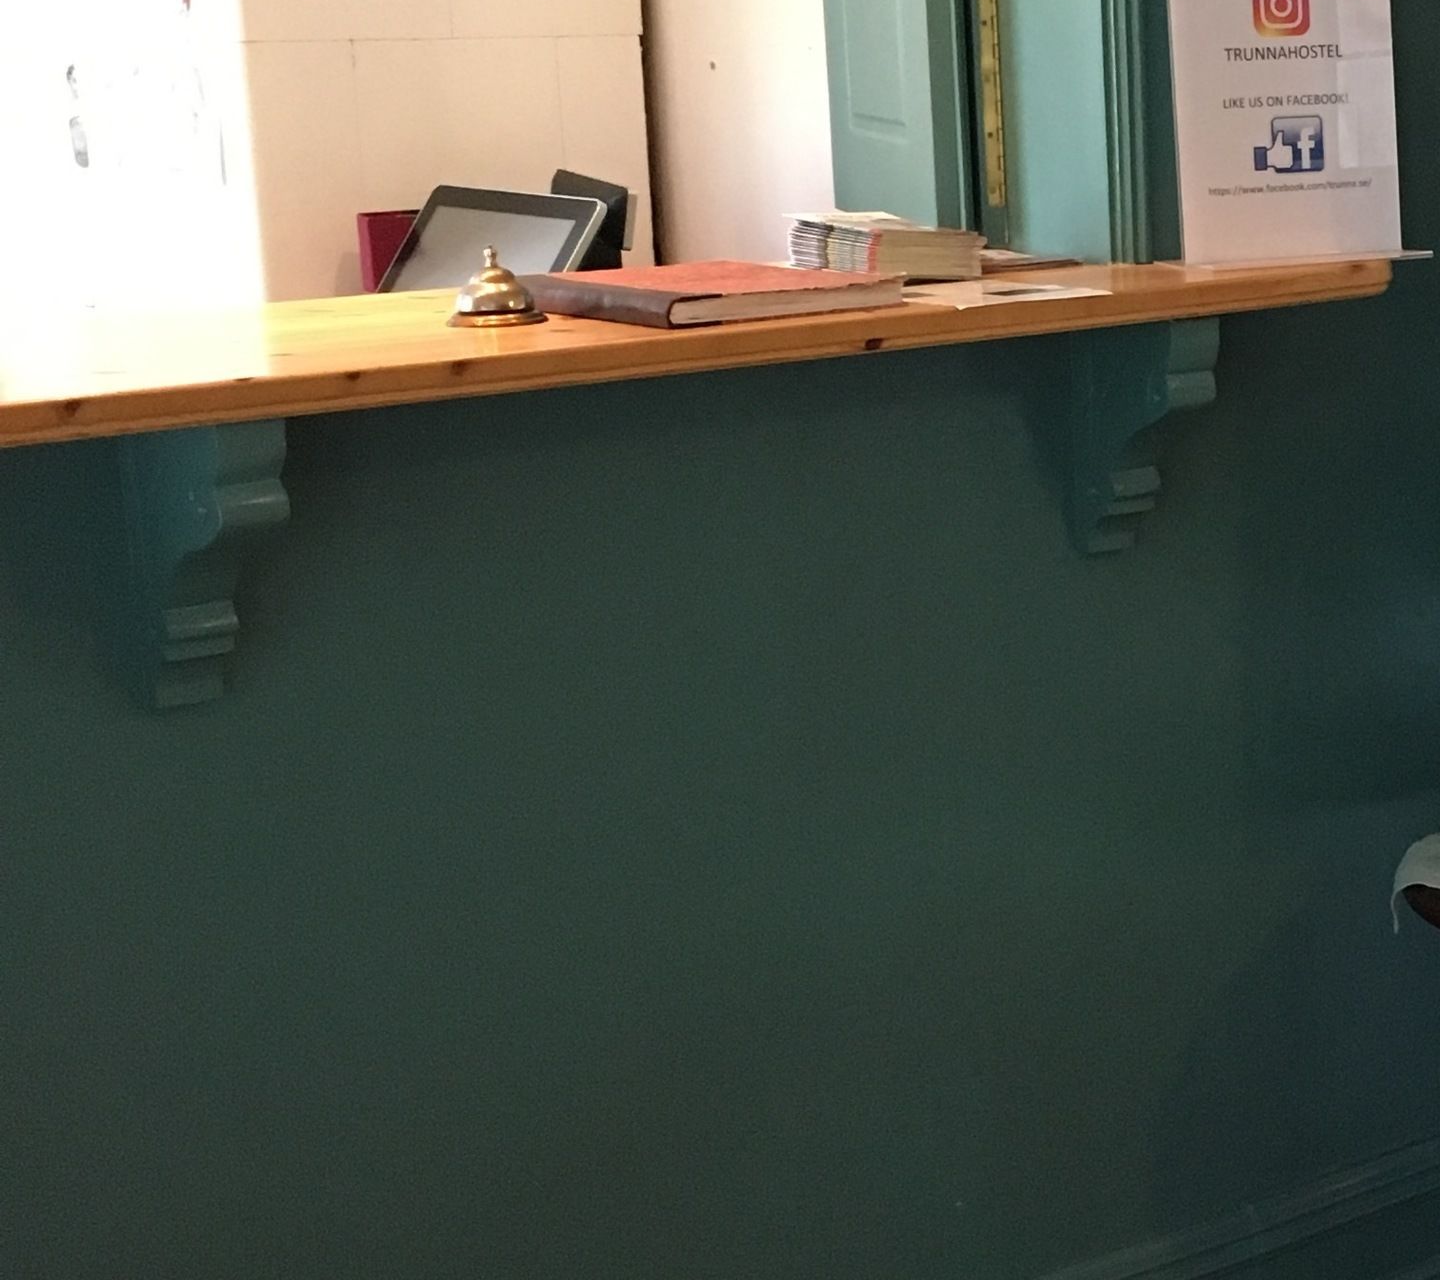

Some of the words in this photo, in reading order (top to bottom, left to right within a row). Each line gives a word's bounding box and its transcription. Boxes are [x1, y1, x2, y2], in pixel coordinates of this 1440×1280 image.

[1224, 44, 1343, 62] TRUNNAHOSTEL
[1223, 98, 1245, 109] LIKE
[1249, 97, 1263, 108] US
[1266, 96, 1283, 107] ON
[1286, 93, 1349, 106] FACEBOOK!
